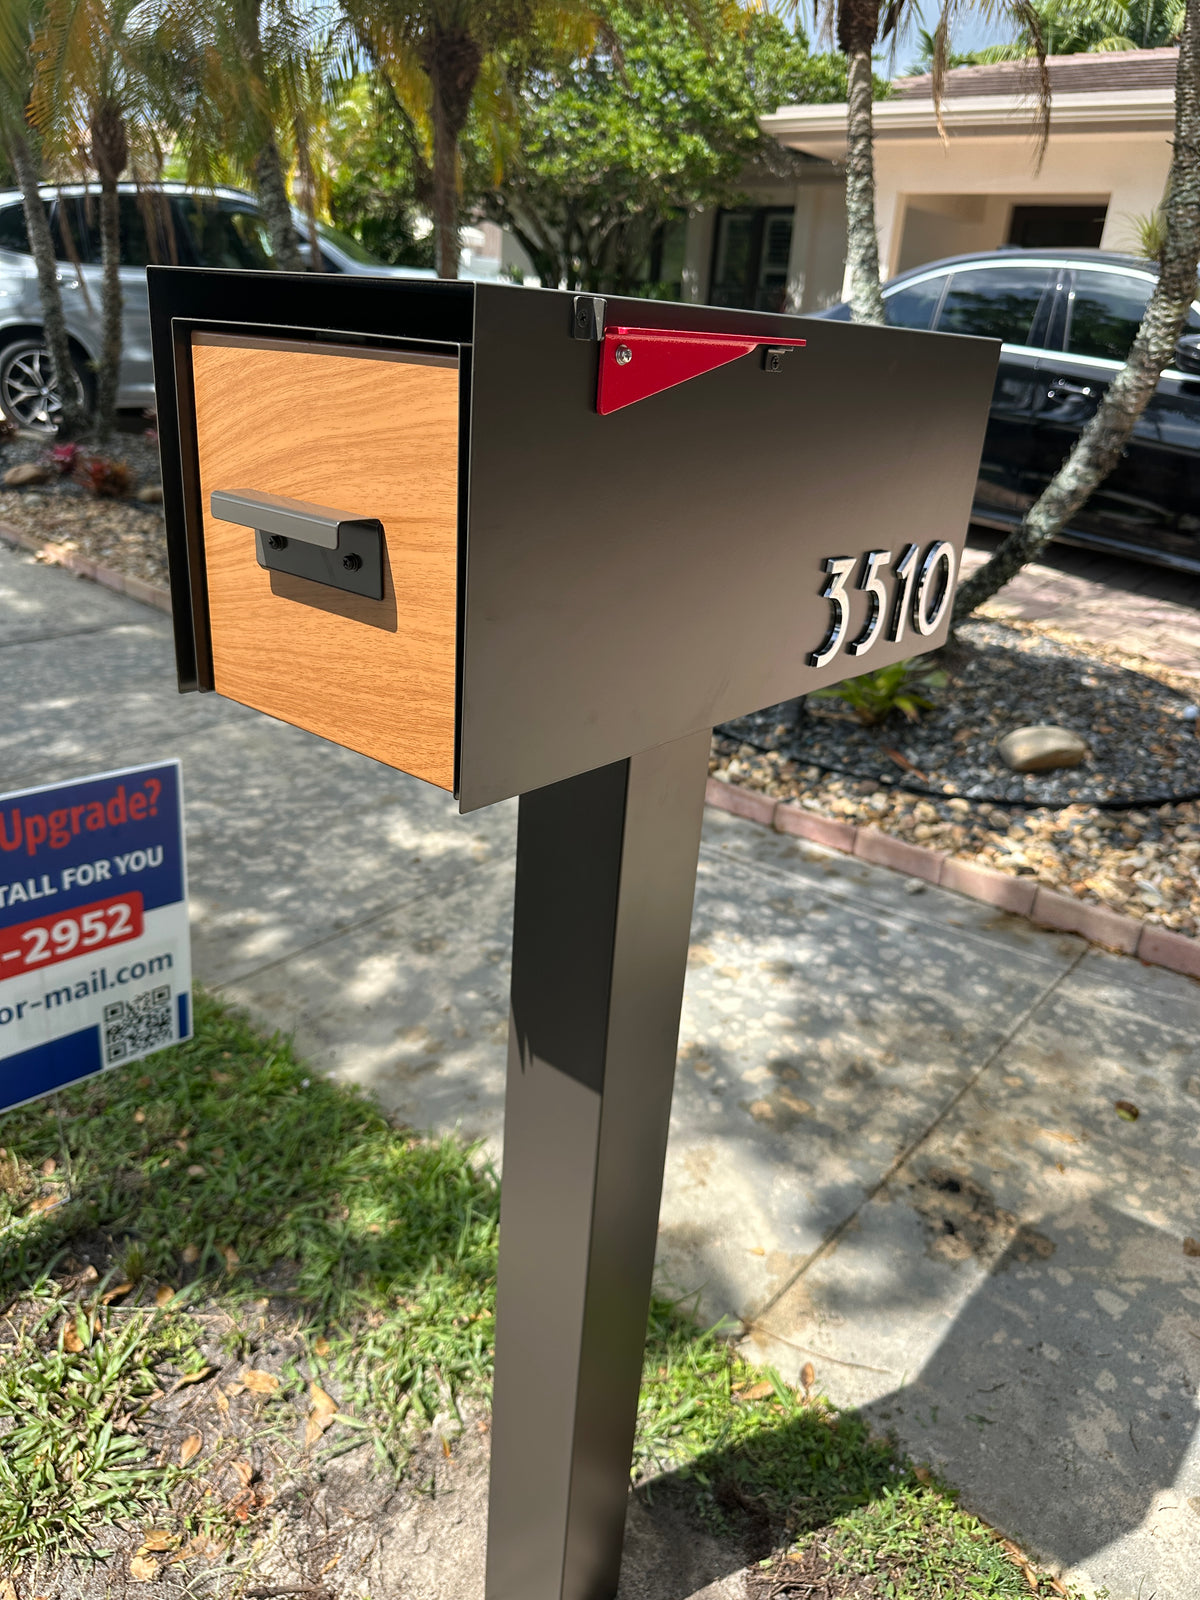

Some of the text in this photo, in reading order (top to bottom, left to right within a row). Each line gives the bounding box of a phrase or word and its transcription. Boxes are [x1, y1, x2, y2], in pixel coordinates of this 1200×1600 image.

[804, 541, 955, 668] 3510
[0, 778, 162, 856] Upgrade?
[0, 845, 164, 908] TALL FOR YOU
[1, 902, 133, 966] -2952
[0, 952, 174, 1025] or-mail.com
